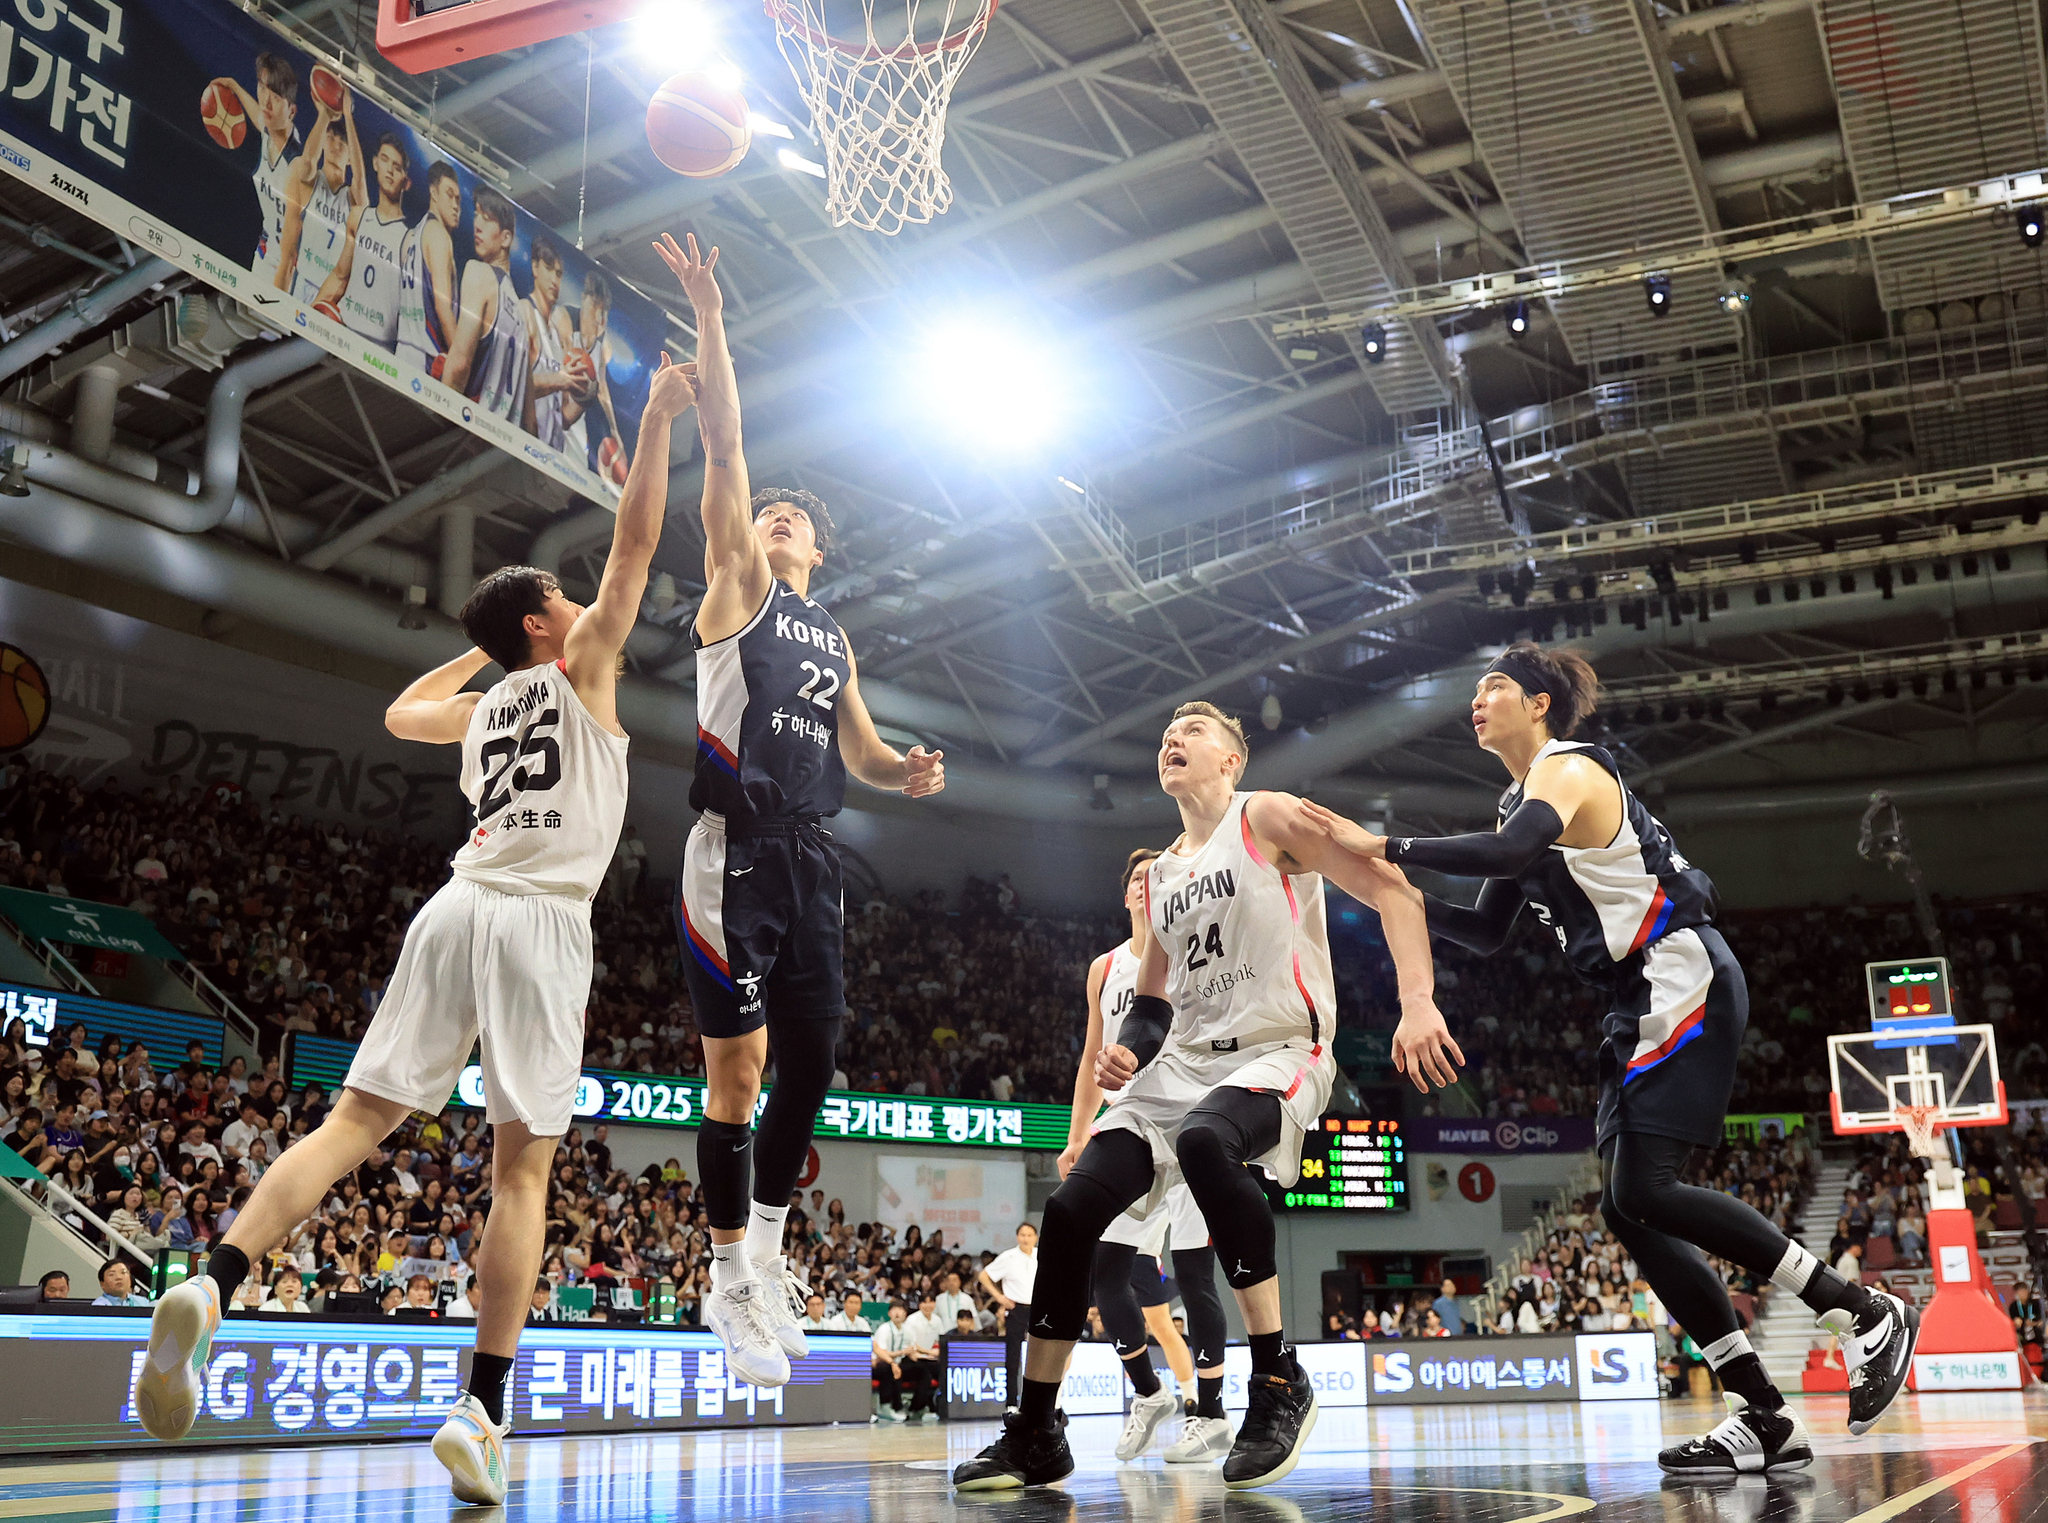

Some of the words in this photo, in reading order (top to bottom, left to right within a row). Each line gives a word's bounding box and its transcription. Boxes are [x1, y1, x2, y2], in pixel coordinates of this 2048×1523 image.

[0, 20, 131, 168] 가전
[50, 173, 88, 205] 치지직
[315, 198, 346, 223] KOREA
[147, 229, 163, 246] 후원
[327, 228, 335, 249] 7
[358, 235, 393, 263] KOREA
[363, 352, 398, 379] NAVER
[797, 660, 840, 711] 22
[142, 719, 457, 823] DEFENSE
[478, 708, 561, 821] 25
[215, 783, 242, 806] 21
[1162, 868, 1235, 934] JAPAN
[1187, 922, 1225, 972] 24
[610, 1080, 692, 1121] 2025
[822, 1097, 935, 1138] 국가대표
[942, 1105, 1023, 1144] 평가전
[1439, 1129, 1490, 1143] NAVER
[1522, 1126, 1559, 1147] Clip
[1301, 1159, 1325, 1178] 34
[1469, 1171, 1482, 1195] 1
[267, 1343, 461, 1430] 경영으로
[528, 1350, 568, 1420] 큰
[581, 1347, 685, 1420] 미래를
[1067, 1375, 1118, 1397] DONGSEO
[1419, 1356, 1571, 1391] 아이에스동서
